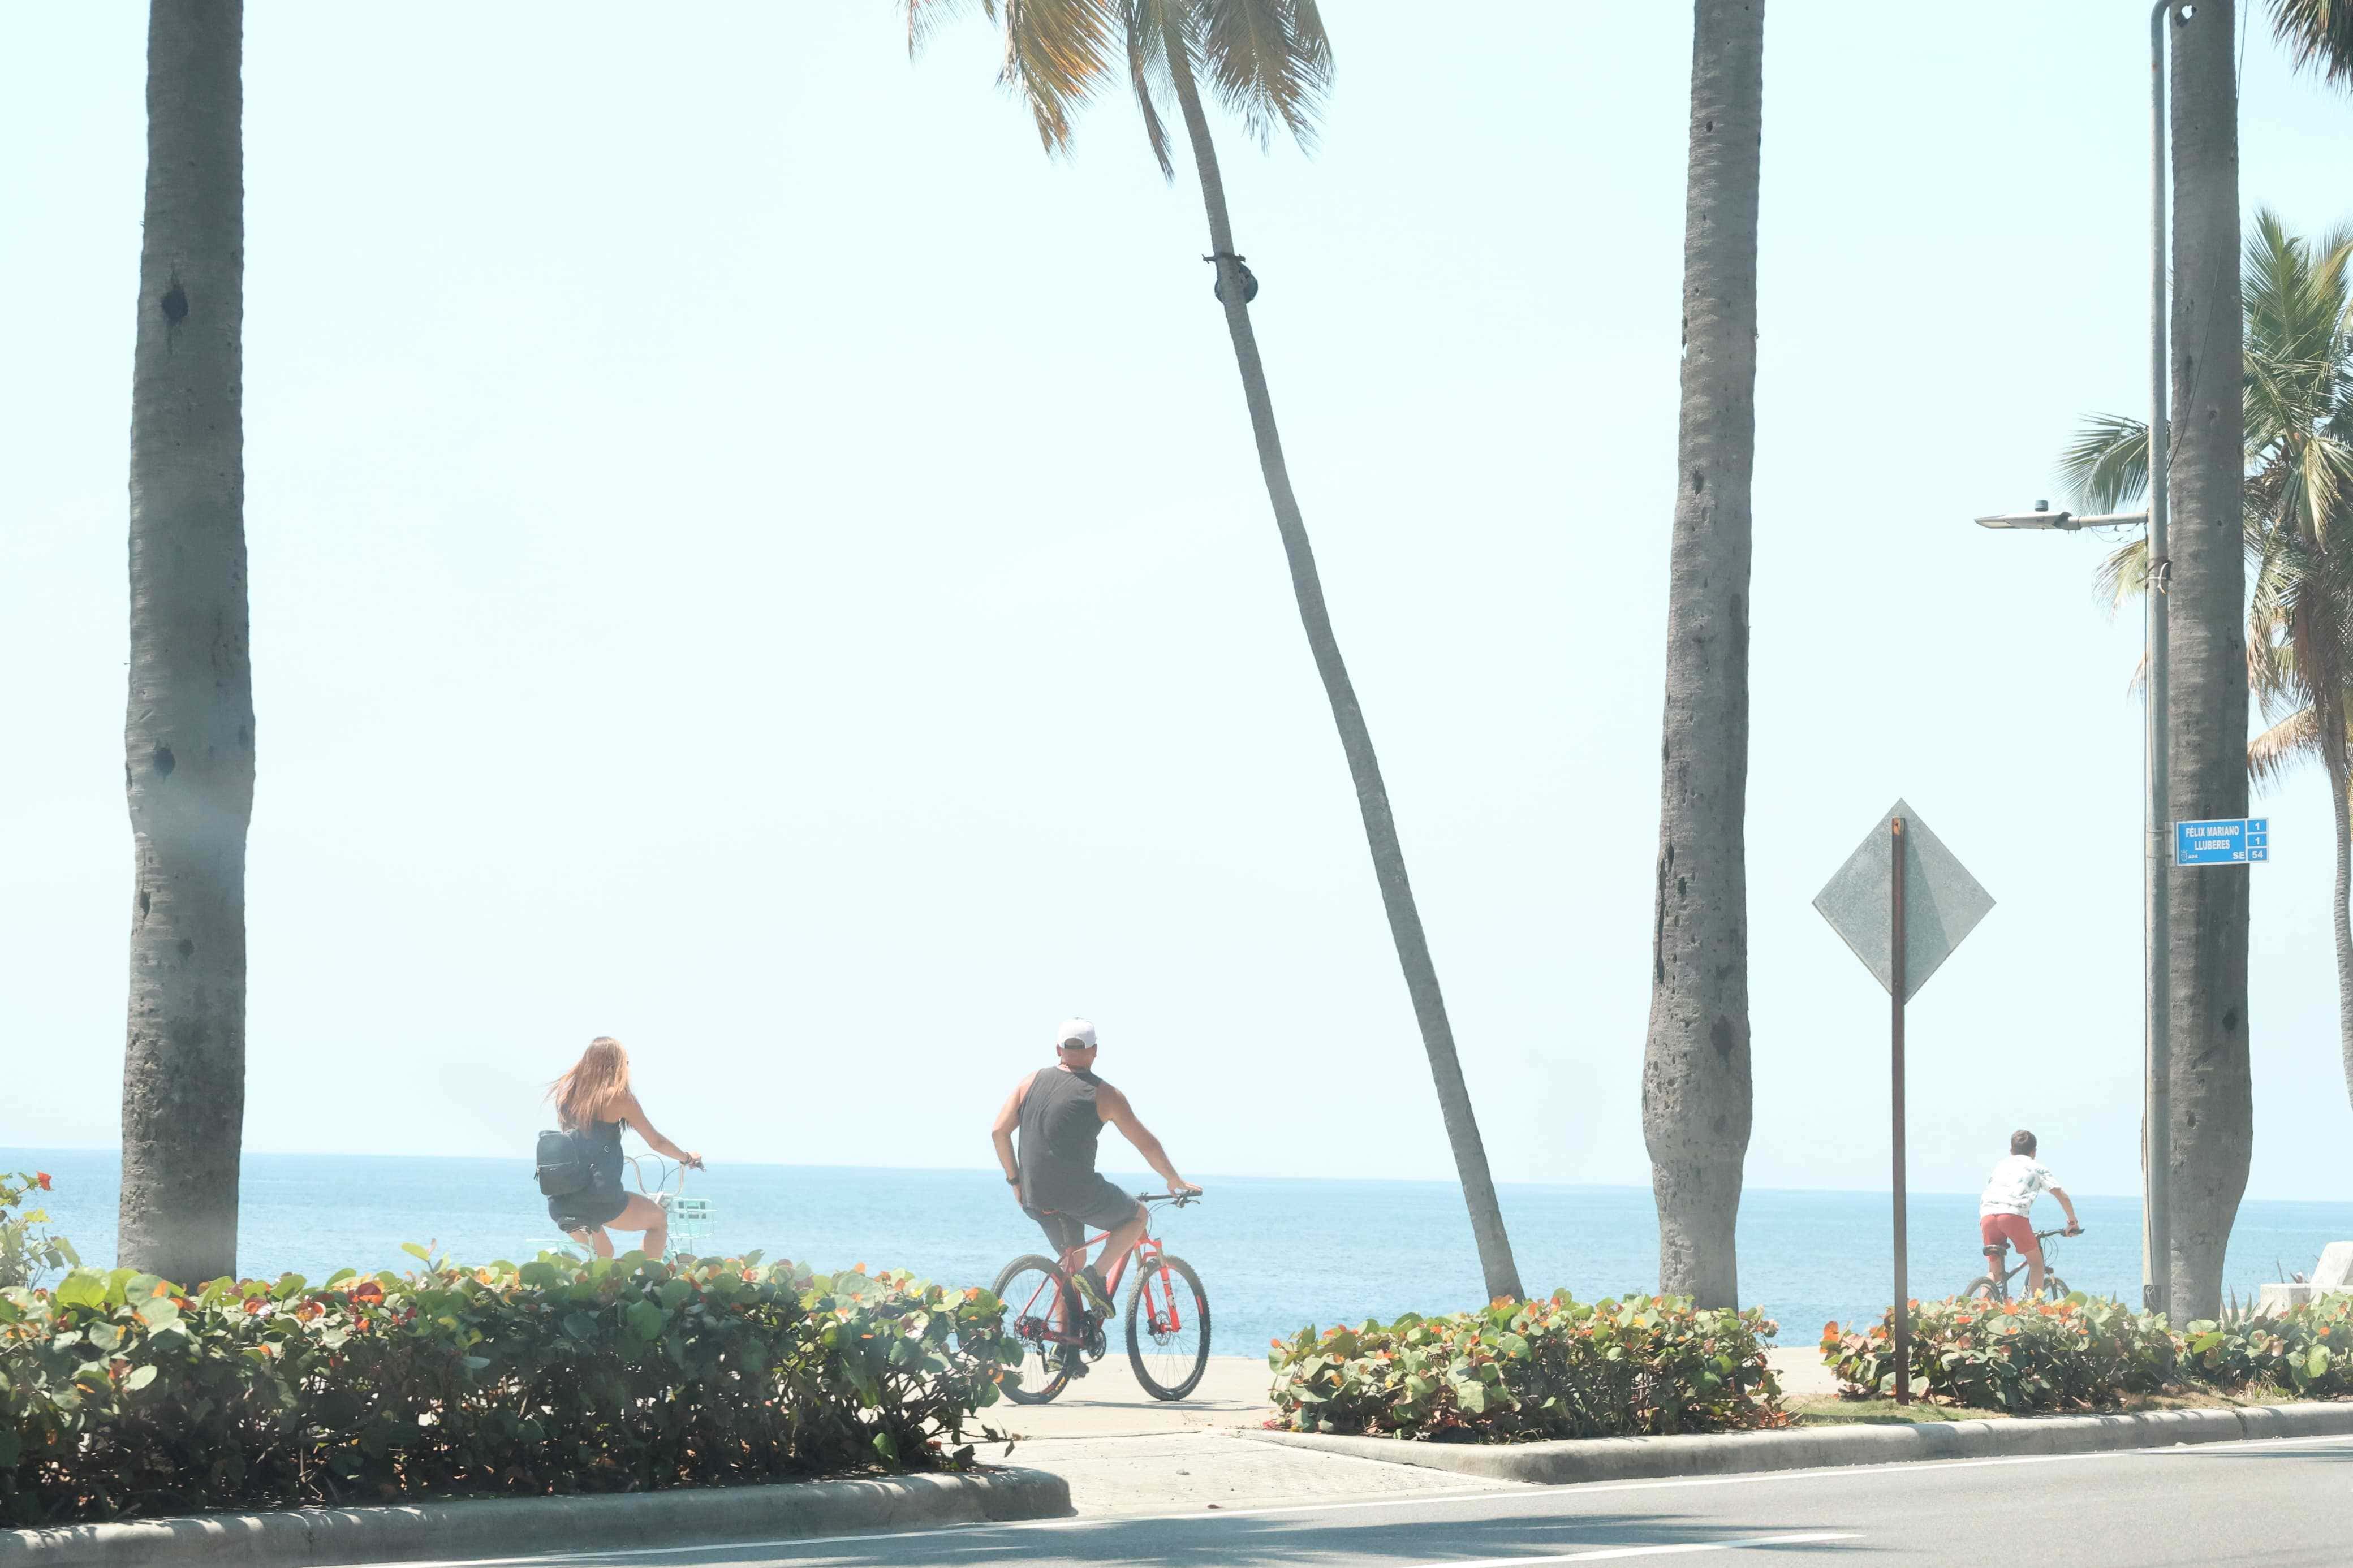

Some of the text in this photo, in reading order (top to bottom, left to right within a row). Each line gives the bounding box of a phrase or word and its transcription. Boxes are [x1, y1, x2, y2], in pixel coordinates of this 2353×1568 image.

[2186, 826, 2239, 837] FÉLIX MARIANO
[2195, 840, 2230, 850] LLUBERES
